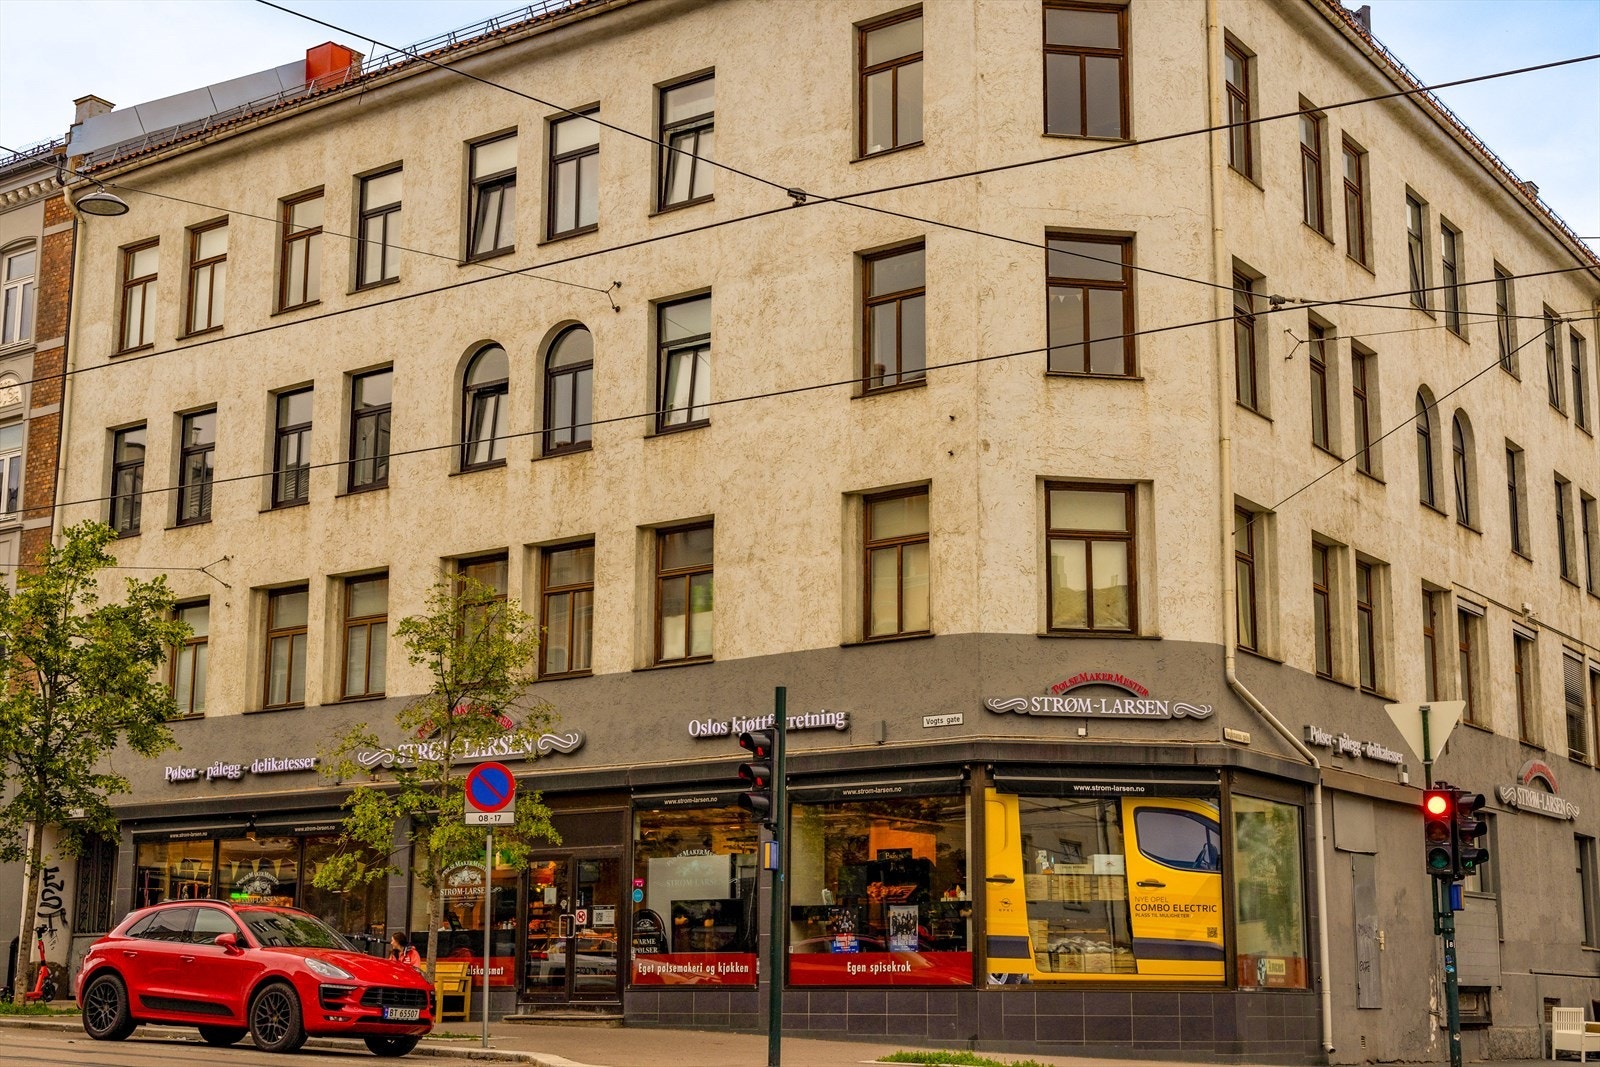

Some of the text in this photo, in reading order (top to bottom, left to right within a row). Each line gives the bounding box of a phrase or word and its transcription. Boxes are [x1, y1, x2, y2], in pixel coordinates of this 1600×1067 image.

[946, 716, 960, 724] gate
[688, 718, 728, 736] Oslos
[165, 757, 316, 781] Pølser pålegg delikatesser
[842, 786, 902, 795] www.strom-larsen.no
[1073, 784, 1145, 792] www.strom-larsen.no
[664, 796, 718, 805] www.strom-larsen.no
[440, 887, 486, 896] STRØM-LARSE
[1173, 904, 1217, 912] ELECTRIC
[638, 962, 654, 976] Eget
[657, 962, 703, 975] pølsemakeri
[706, 965, 715, 975] og
[717, 962, 749, 975] kjøkken
[847, 961, 911, 975] Egen spisekrok
[389, 1009, 418, 1018] BT 65507
